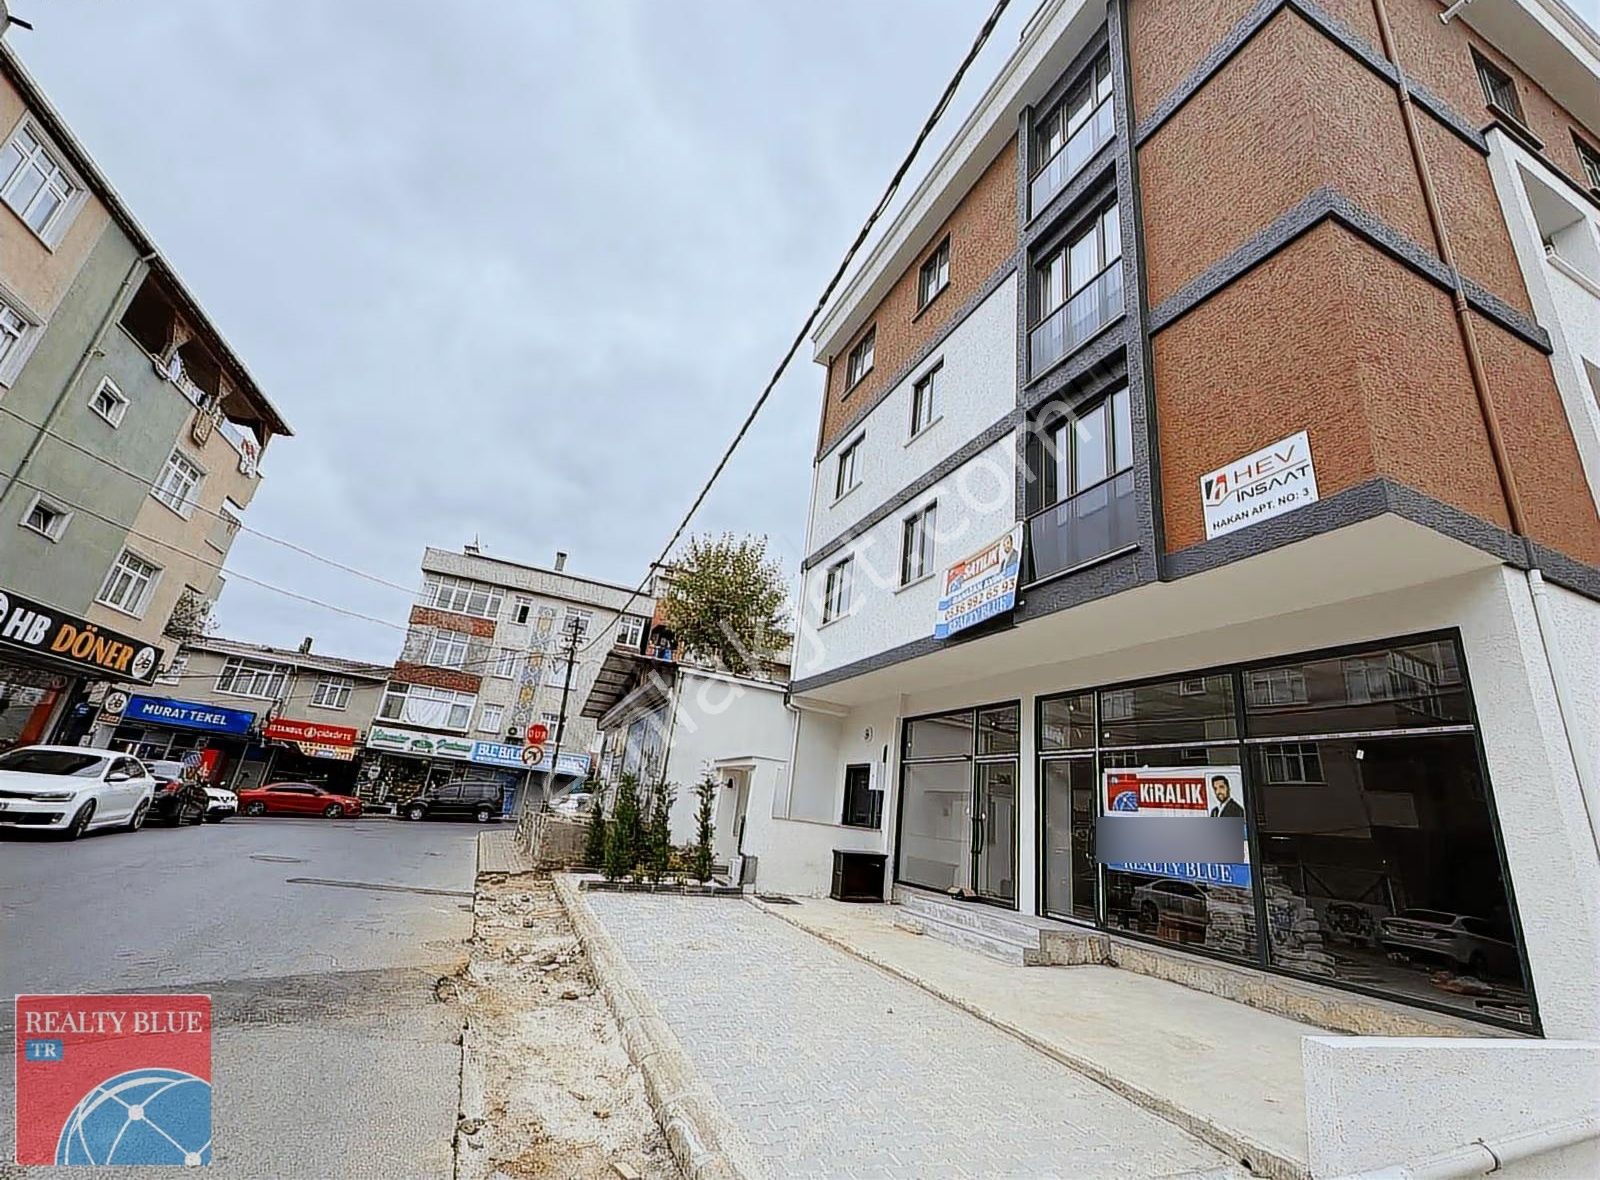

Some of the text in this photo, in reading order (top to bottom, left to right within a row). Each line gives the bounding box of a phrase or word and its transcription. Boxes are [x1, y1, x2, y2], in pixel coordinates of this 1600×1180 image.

[1234, 445, 1295, 485] HEV
[1212, 486, 1310, 531] HAKAN APT. NO: 3
[2, 607, 134, 671] HB DÖNER
[142, 703, 228, 725] MURAT TEKEL
[1186, 862, 1232, 883] BLUE
